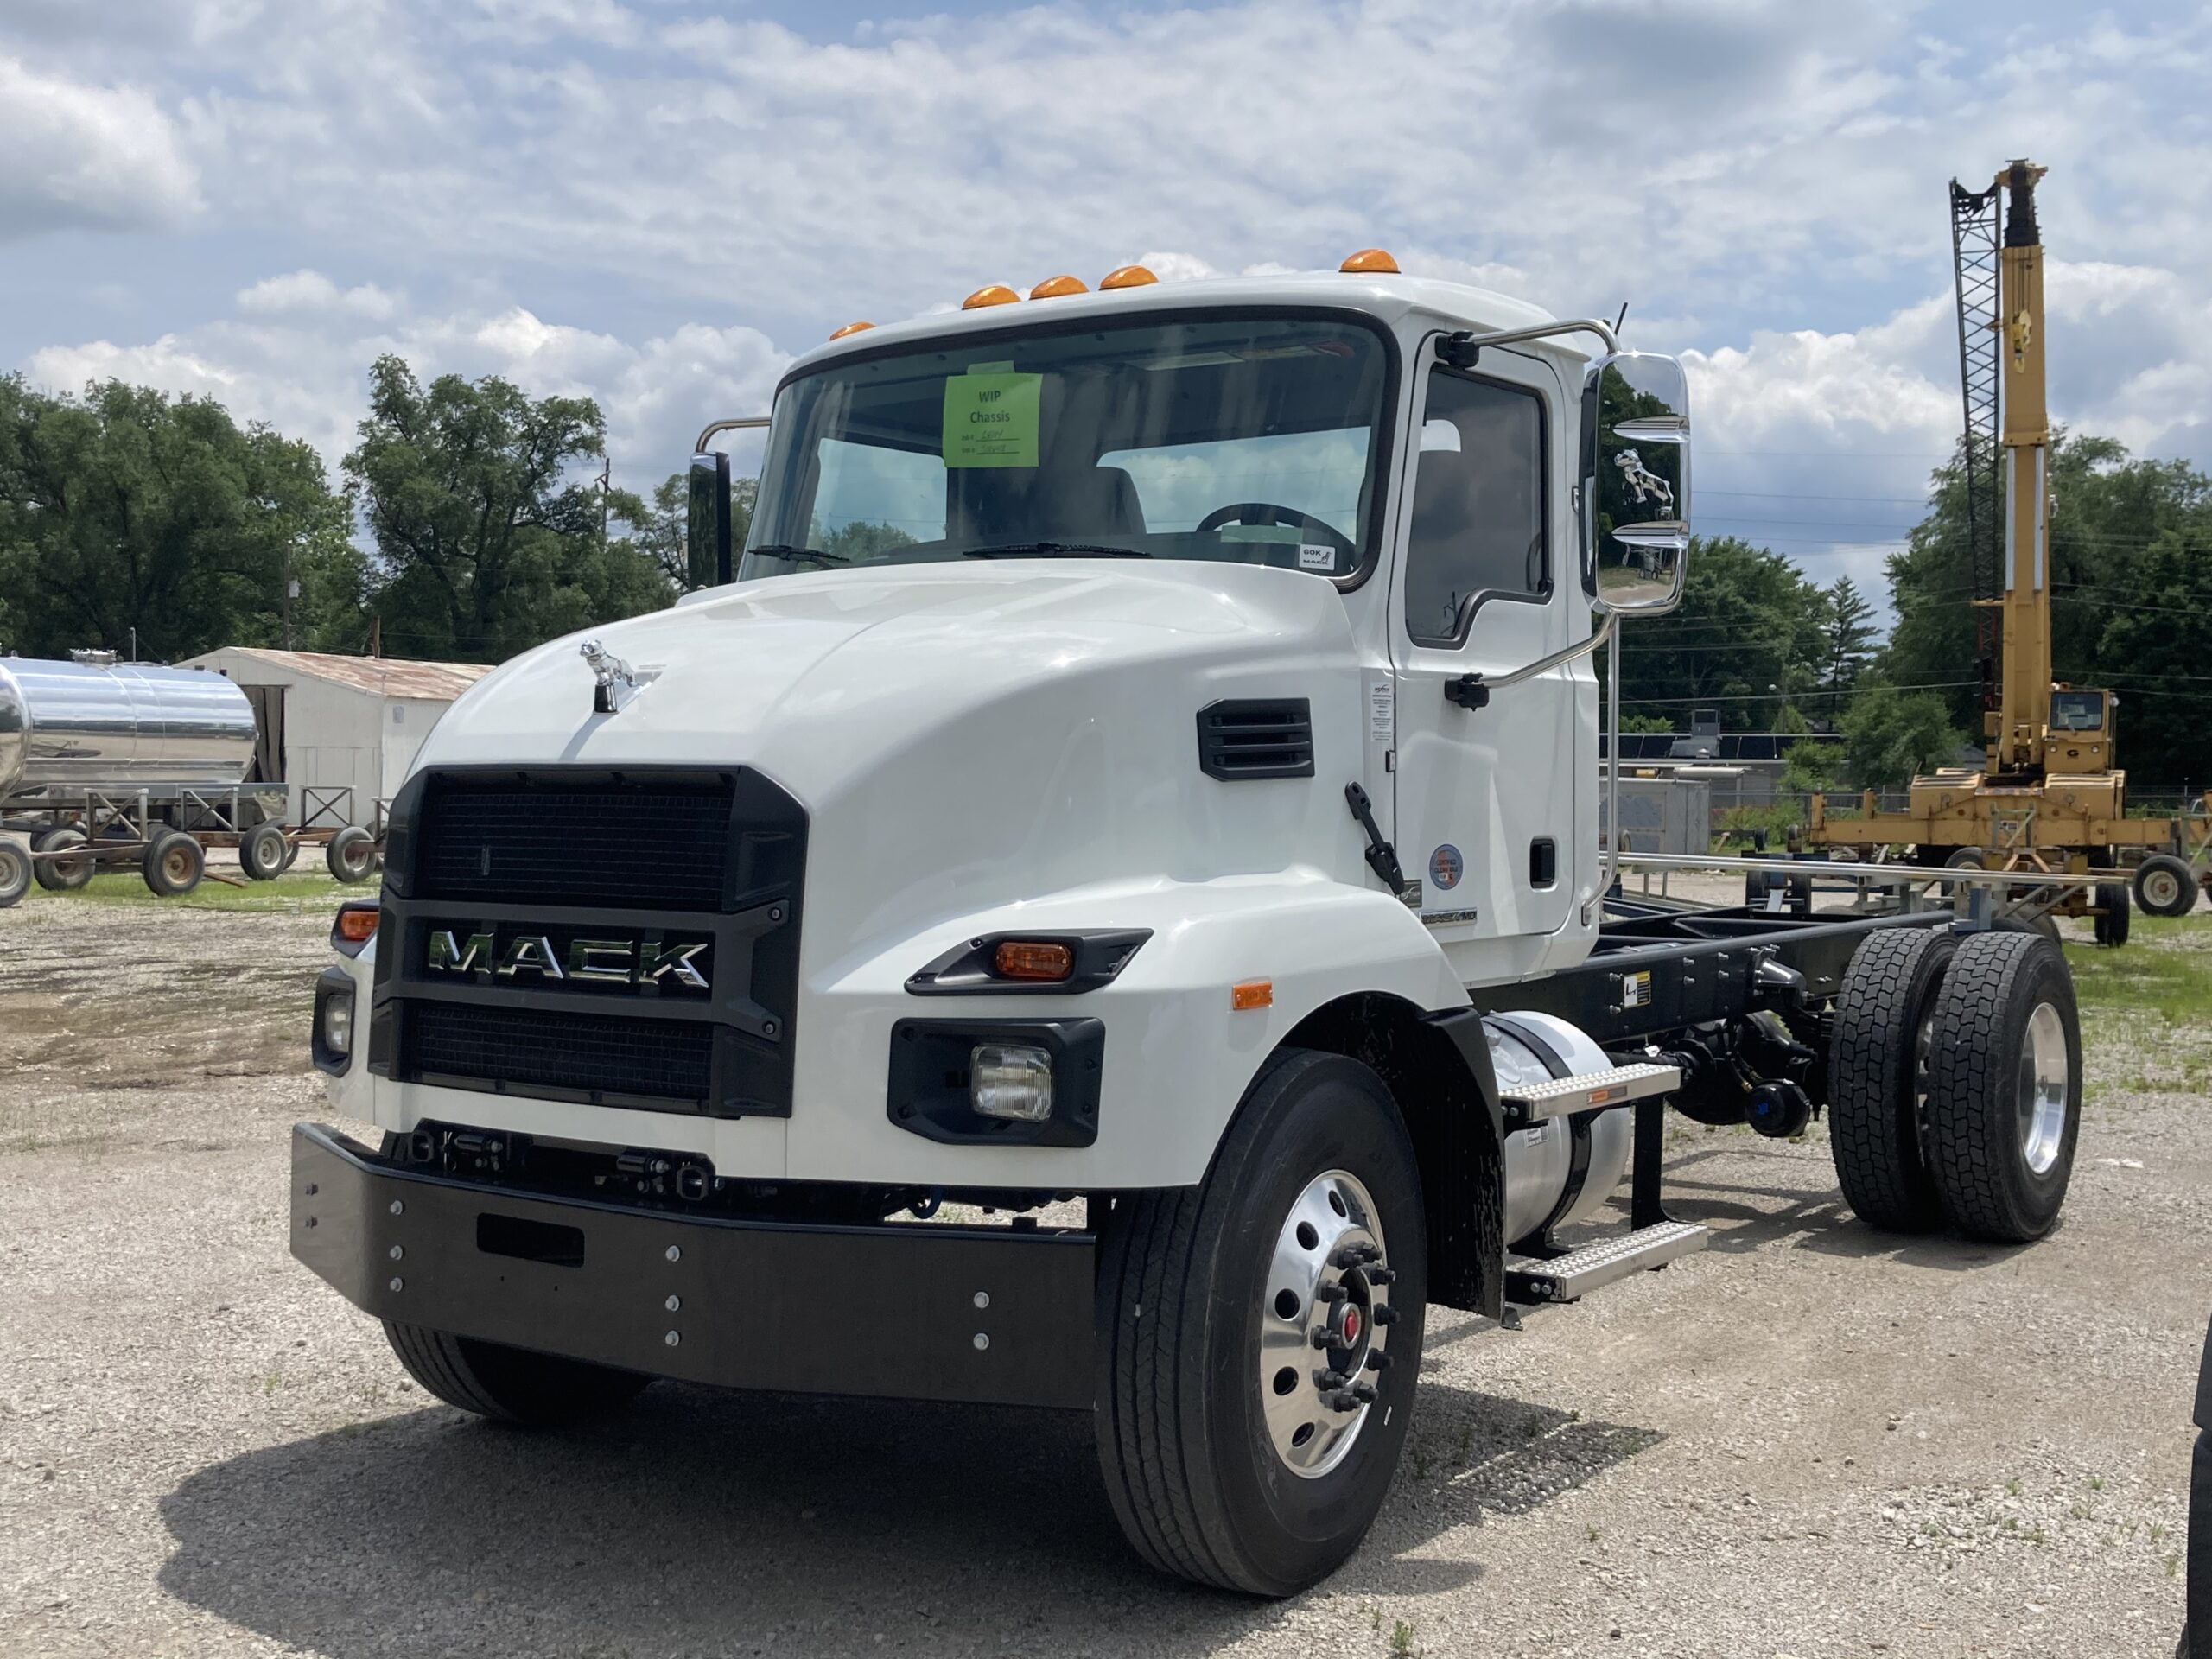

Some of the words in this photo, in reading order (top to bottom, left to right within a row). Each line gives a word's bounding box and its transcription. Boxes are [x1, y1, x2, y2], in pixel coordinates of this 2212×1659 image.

[978, 390, 1001, 403] WIP
[969, 410, 1011, 423] Chassis
[429, 931, 709, 988] MACK
